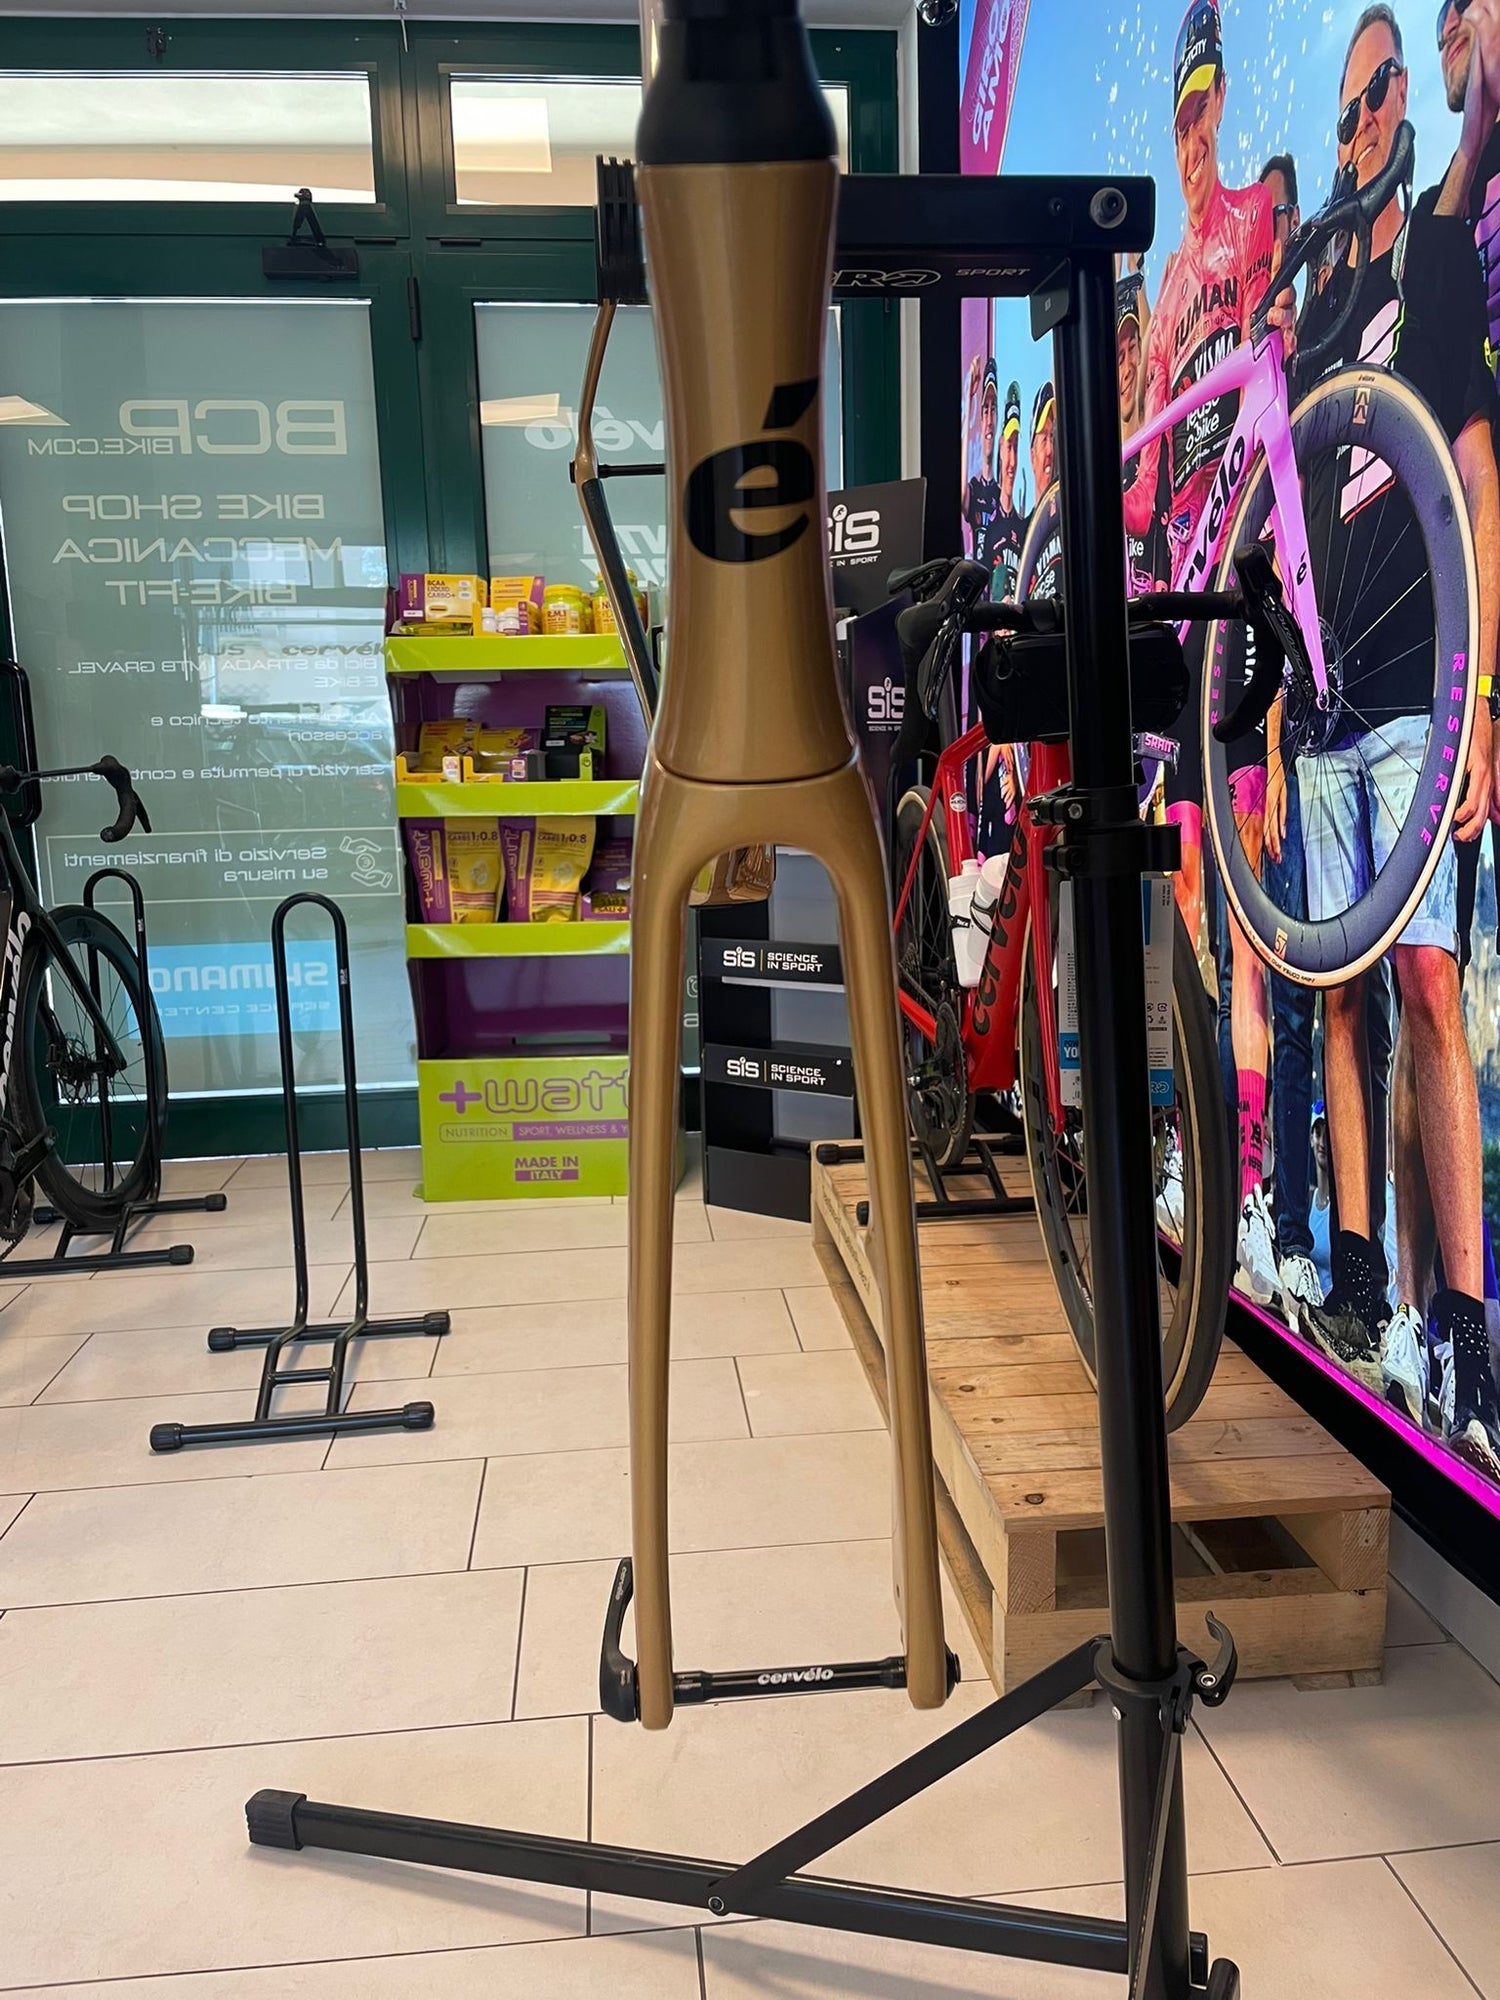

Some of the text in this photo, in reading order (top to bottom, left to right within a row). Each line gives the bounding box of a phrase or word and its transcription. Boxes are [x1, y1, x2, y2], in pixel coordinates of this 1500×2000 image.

[955, 268, 1031, 277] SPORT
[1194, 331, 1235, 381] VISMA
[683, 376, 820, 566] é
[1183, 435, 1245, 592] rvélo
[827, 503, 882, 553] iS
[1128, 537, 1145, 557] ike
[836, 555, 878, 567] IN SPORT
[427, 579, 446, 587] BCAA
[1144, 732, 1174, 753] SRAM
[1420, 652, 1467, 847] RESERVE
[971, 822, 1028, 1037] cervélo
[767, 951, 819, 964] SCIENCE
[767, 960, 824, 972] IN SPORT
[770, 1063, 822, 1077] SCIENCE
[770, 1072, 827, 1086] IN SPORT
[445, 1127, 508, 1138] NUTRITION
[555, 1124, 607, 1136] WELLNESS
[514, 1155, 579, 1169] MADE IN
[529, 1169, 565, 1181] ITALY
[757, 1666, 835, 1686] cervélo
